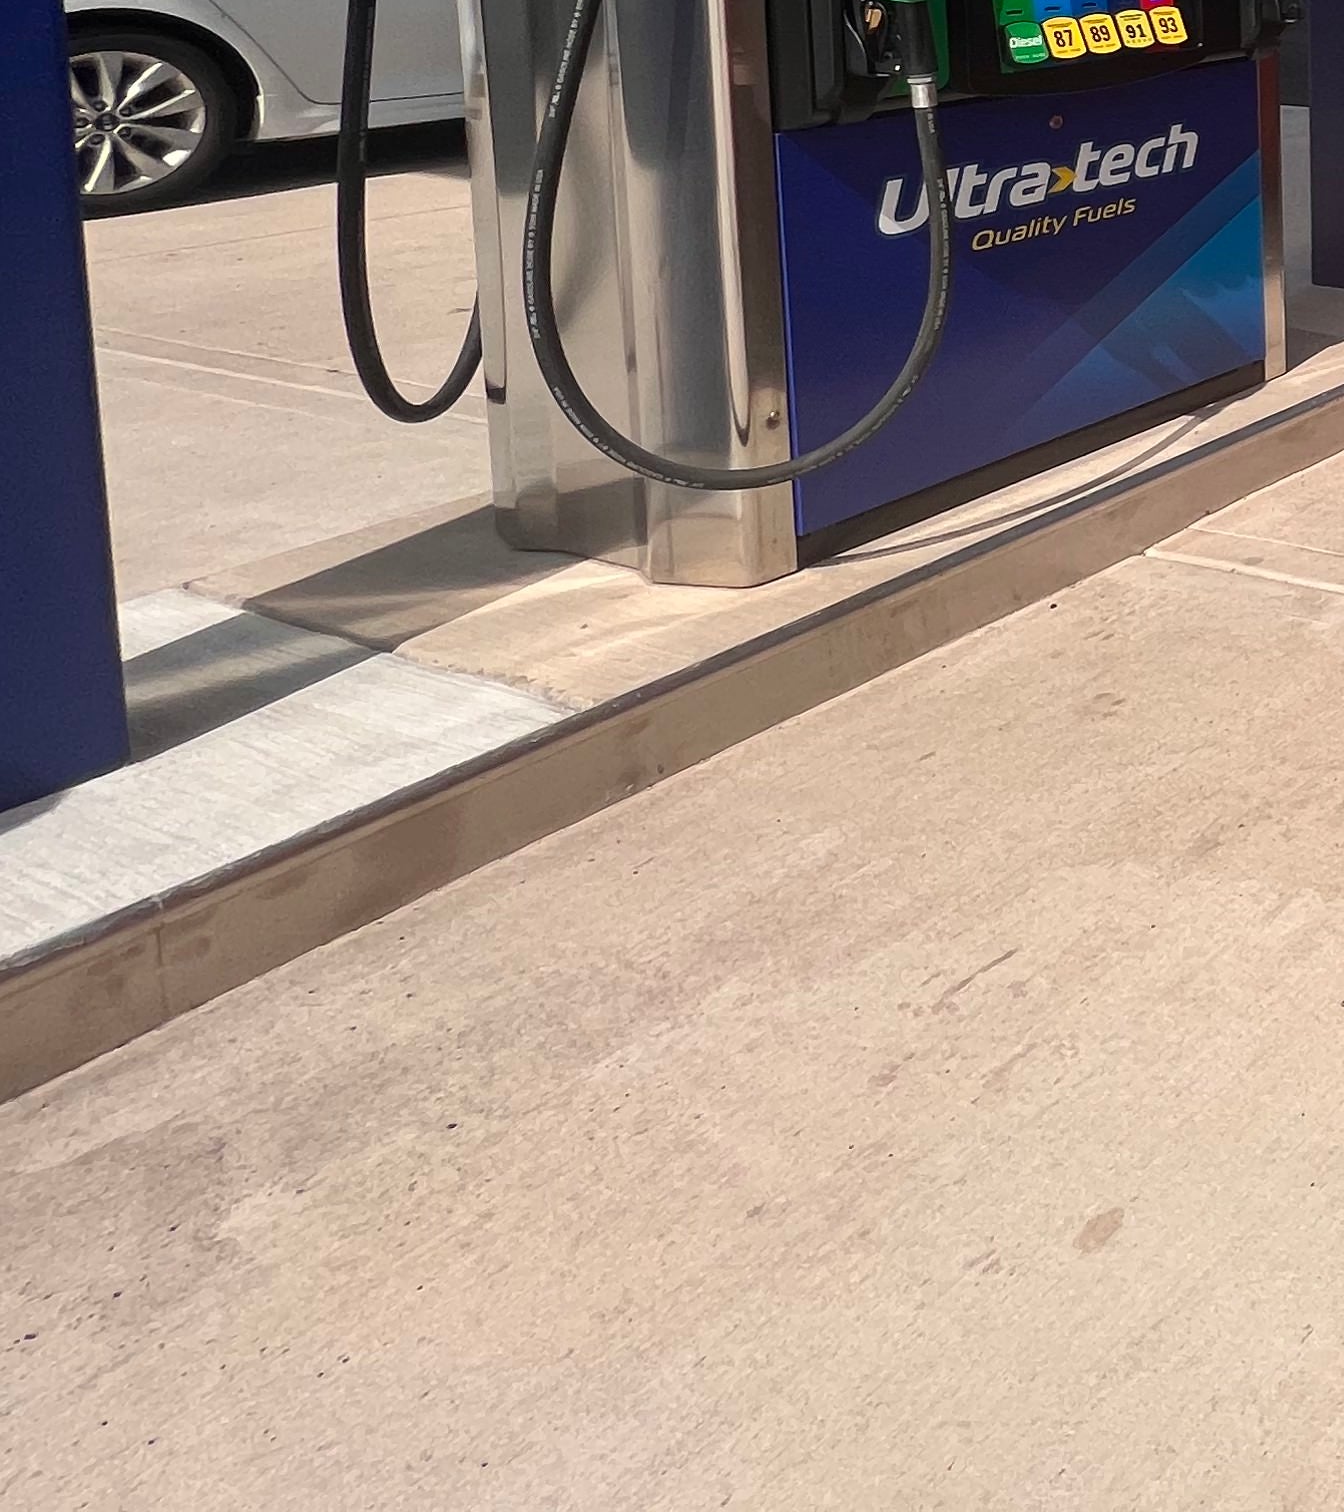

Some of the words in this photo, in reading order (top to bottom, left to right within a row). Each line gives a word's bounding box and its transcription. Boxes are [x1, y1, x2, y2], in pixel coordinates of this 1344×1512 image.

[1089, 24, 1111, 43] 89
[1125, 23, 1148, 40] 91
[1158, 16, 1179, 34] 93
[1053, 28, 1074, 48] 87
[971, 215, 1067, 253] Quality
[1073, 196, 1137, 229] Fuels
